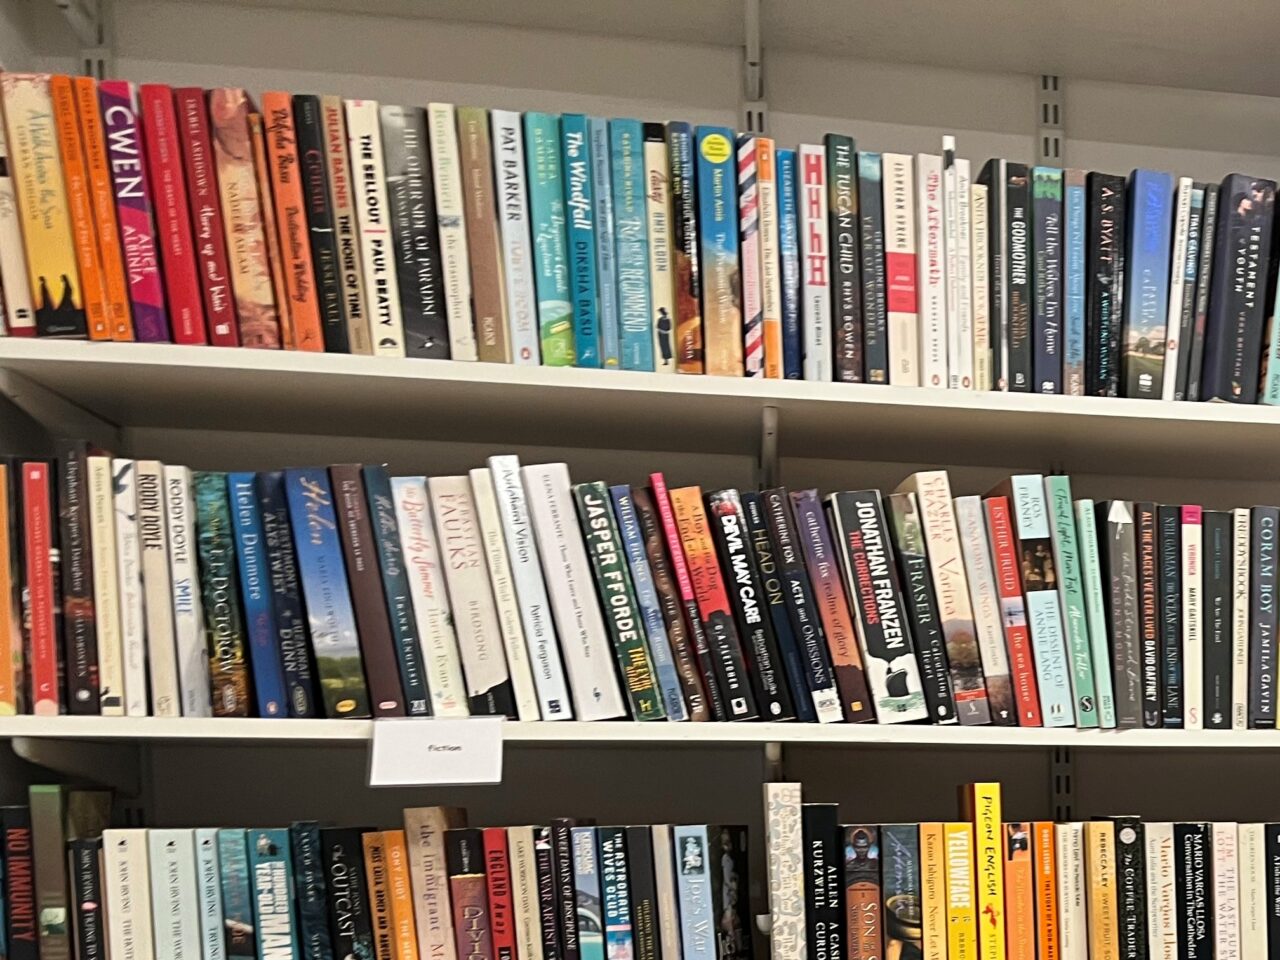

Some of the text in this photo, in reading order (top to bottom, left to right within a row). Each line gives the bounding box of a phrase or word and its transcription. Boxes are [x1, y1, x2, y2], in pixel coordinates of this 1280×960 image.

[105, 105, 144, 198] CWEN
[502, 127, 521, 221] PAT BARKER
[566, 132, 591, 230] The Windfall
[123, 225, 140, 284] ALBINIA
[139, 234, 158, 275] ALICE
[359, 135, 392, 326] THE SELLOUT PAUL BEATTY
[836, 144, 852, 274] THE TUSCAN CHILD
[141, 474, 162, 550] RODDY DOYLE
[169, 478, 192, 616] RODDY DOYLE SMILE
[584, 495, 638, 642] JASPER FFORDE
[849, 530, 879, 624] THE CORRECTIONS
[856, 501, 904, 649] JONATHAN FRANZEN
[1260, 517, 1273, 614] CORAM BOY
[7, 828, 31, 853] NO
[948, 831, 971, 909] YELLOWFACE
[983, 796, 997, 896] PIGEON ENGLISH
[7, 859, 34, 942] IMMUNITY
